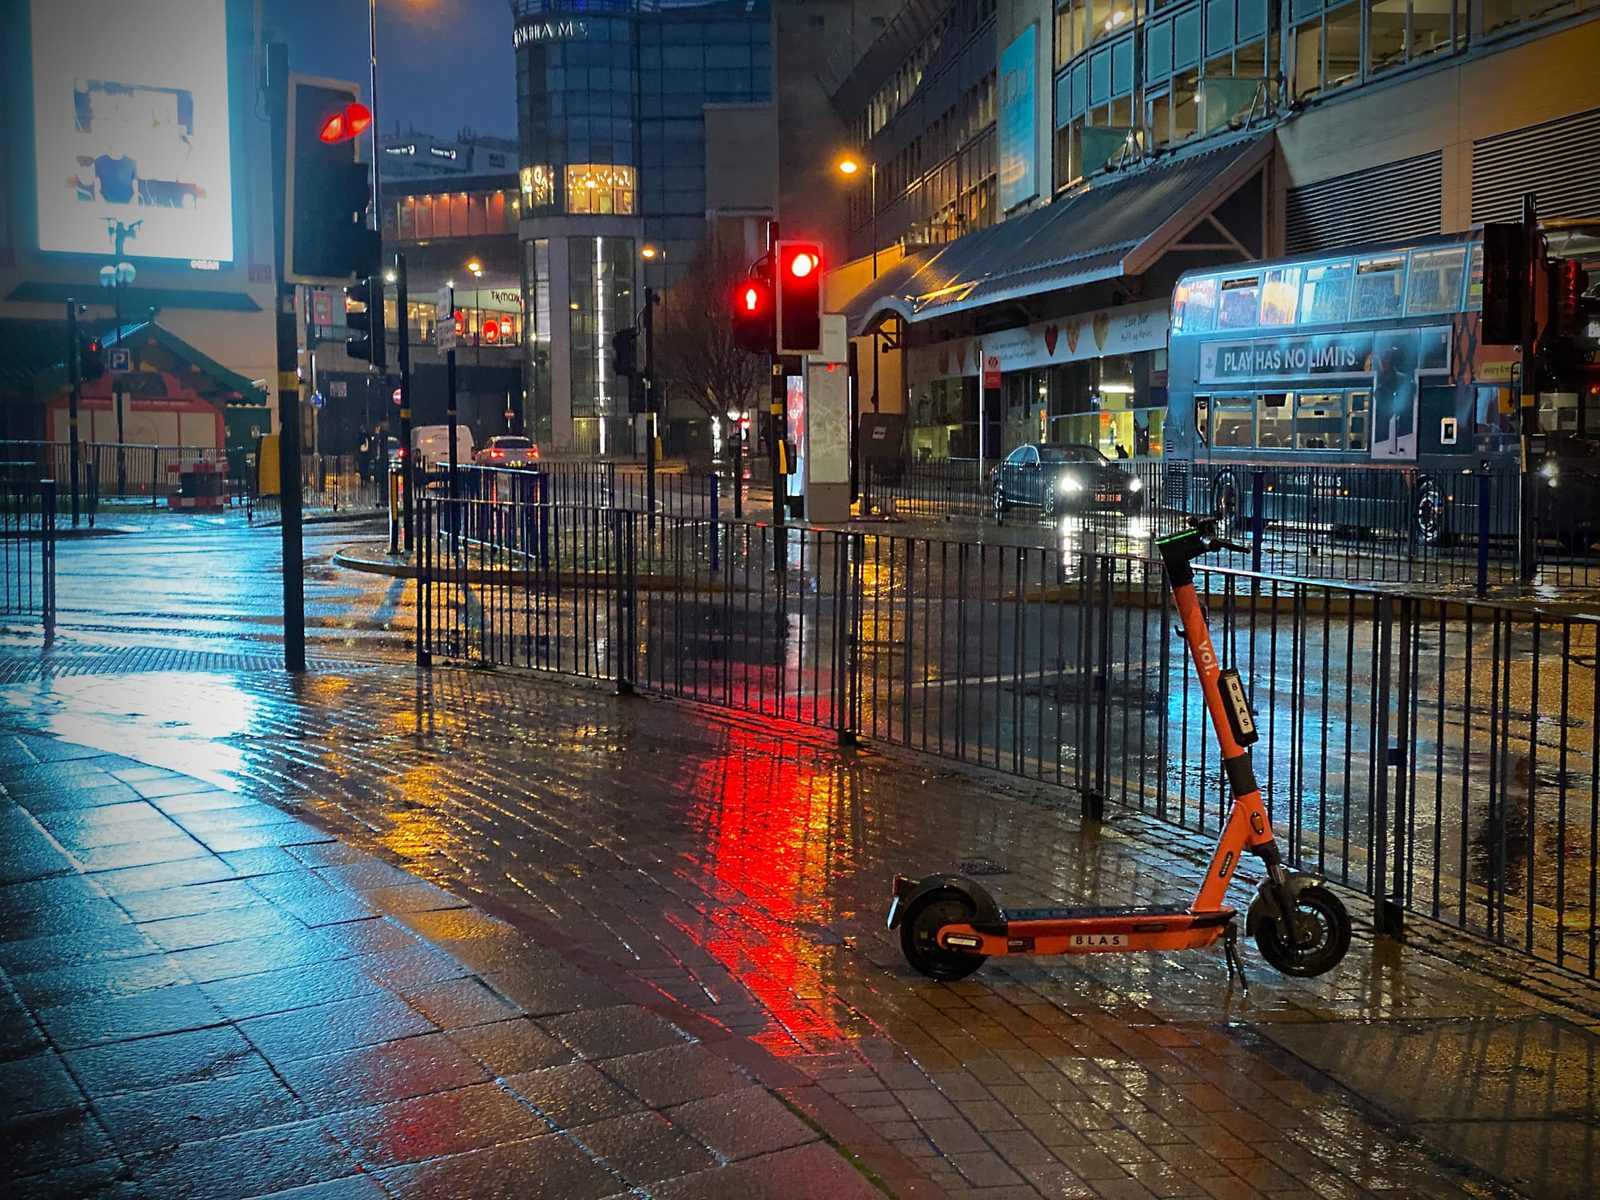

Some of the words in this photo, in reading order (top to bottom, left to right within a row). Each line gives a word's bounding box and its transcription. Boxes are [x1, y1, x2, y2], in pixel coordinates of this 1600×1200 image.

[1224, 350, 1252, 371] PLAY
[1255, 349, 1281, 370] HAS
[1284, 347, 1306, 369] NO
